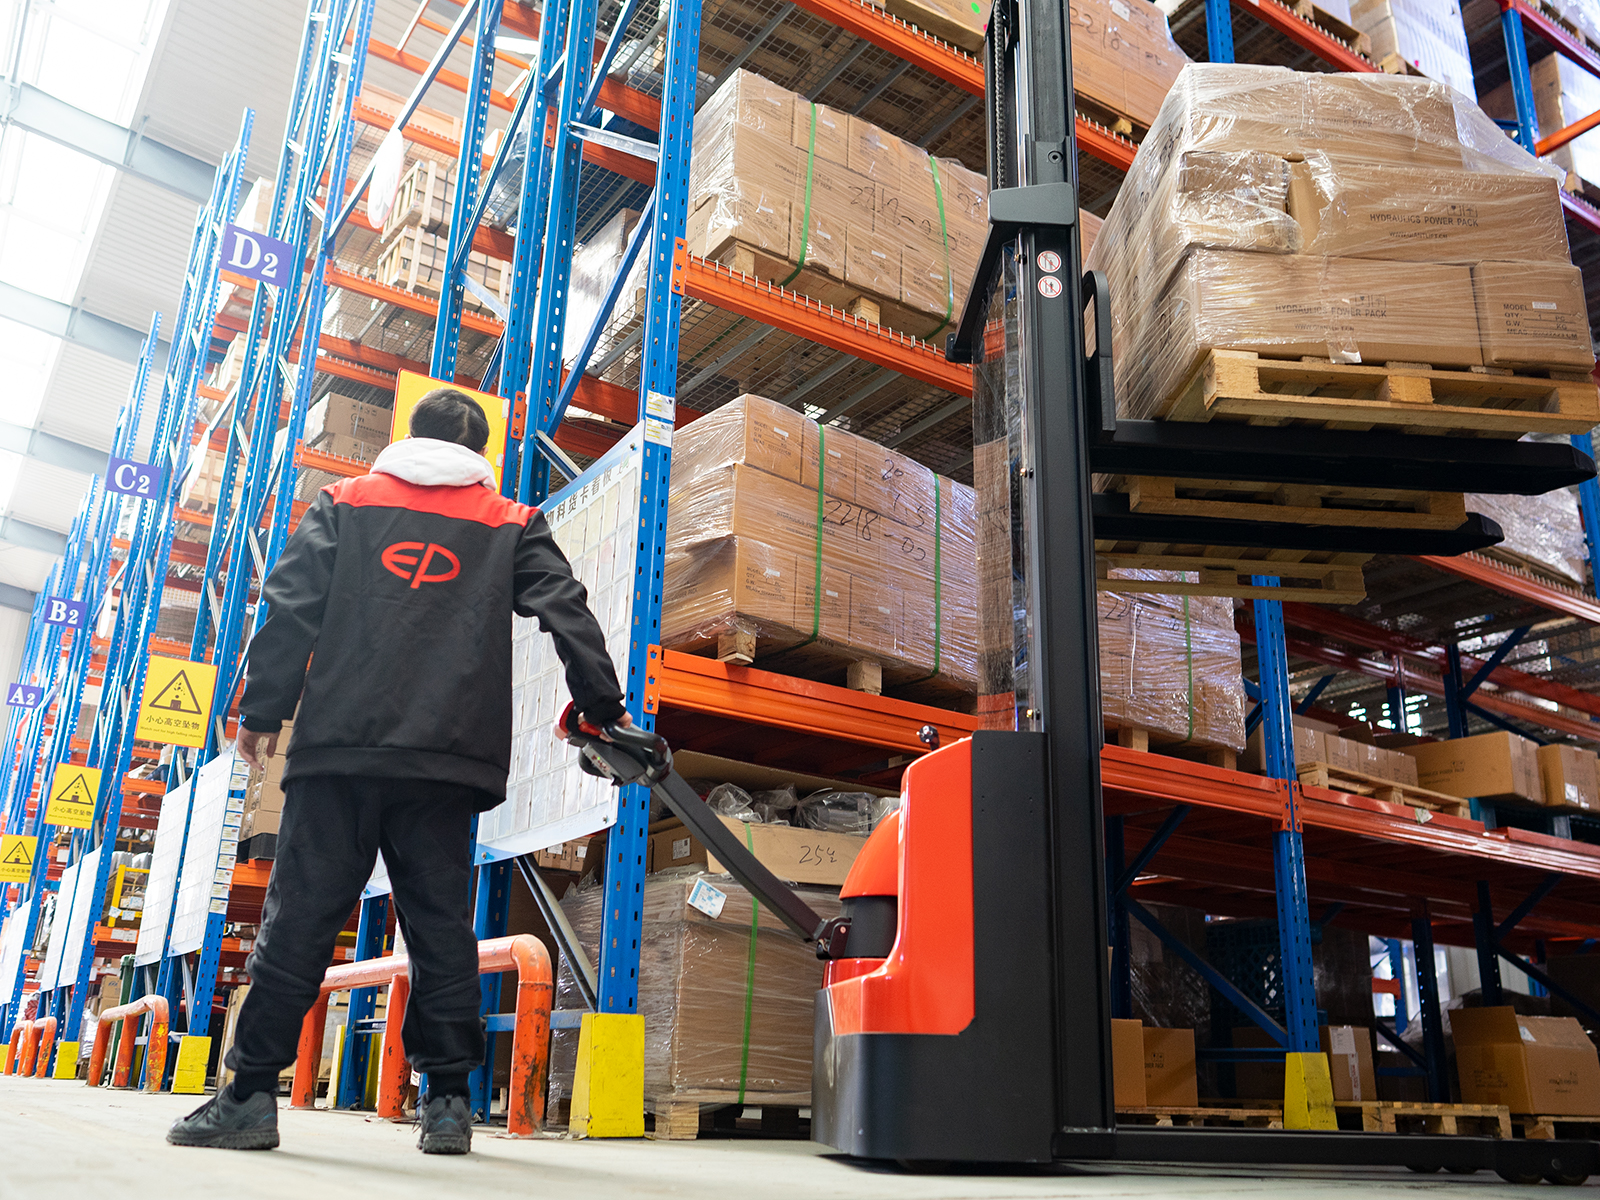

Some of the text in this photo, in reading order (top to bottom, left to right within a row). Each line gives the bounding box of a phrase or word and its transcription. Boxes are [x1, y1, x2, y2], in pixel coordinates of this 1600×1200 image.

[1352, 120, 1373, 128] PACK
[1370, 214, 1479, 227] HYDRAULICS POWER PACK
[227, 231, 279, 279] D2
[1275, 304, 1328, 315] HYDRAULICS
[1365, 308, 1387, 318] PACK
[114, 464, 151, 495] C2
[381, 541, 461, 589] EP
[47, 599, 80, 625] B2
[8, 686, 36, 706] A2
[146, 714, 200, 731] 小心高空坠物
